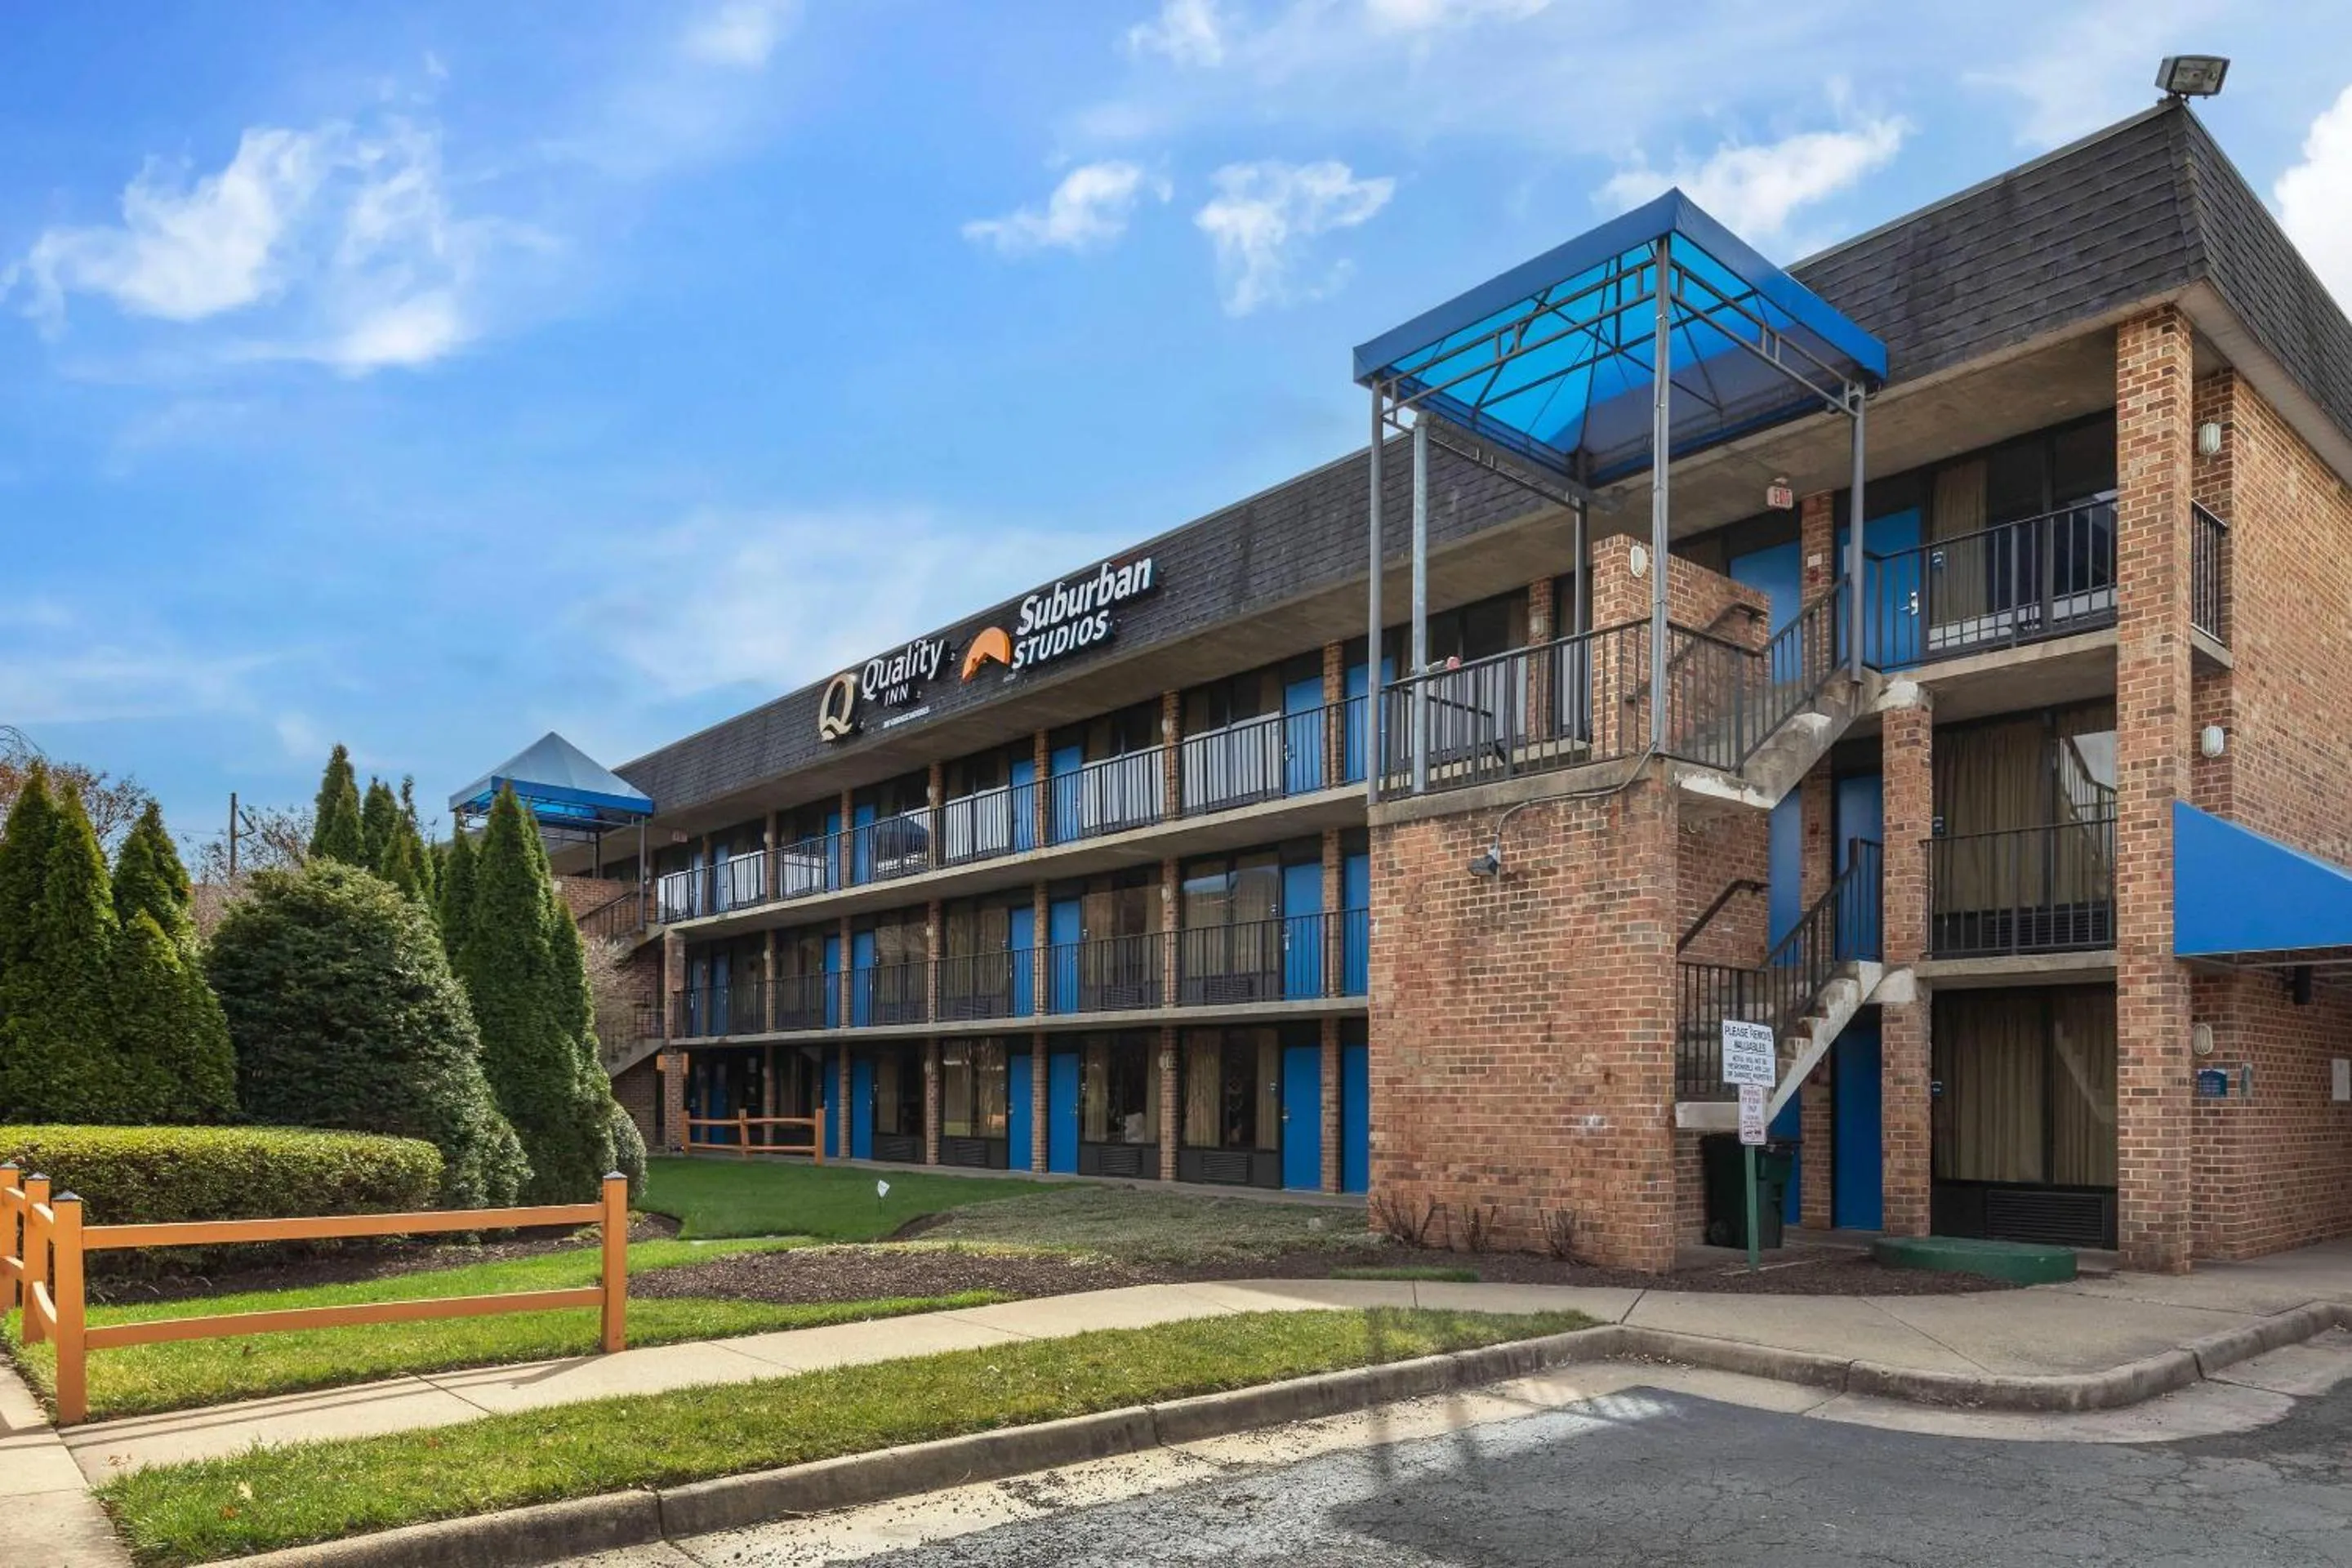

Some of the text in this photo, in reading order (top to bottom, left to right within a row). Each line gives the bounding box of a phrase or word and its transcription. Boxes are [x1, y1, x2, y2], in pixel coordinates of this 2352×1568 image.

[1016, 558, 1152, 635] Suburban
[862, 639, 944, 701] Quality
[1011, 609, 1109, 670] STUDIOS
[819, 673, 857, 742] Q
[884, 684, 908, 706] INN
[1724, 1026, 1748, 1039] PLEASE
